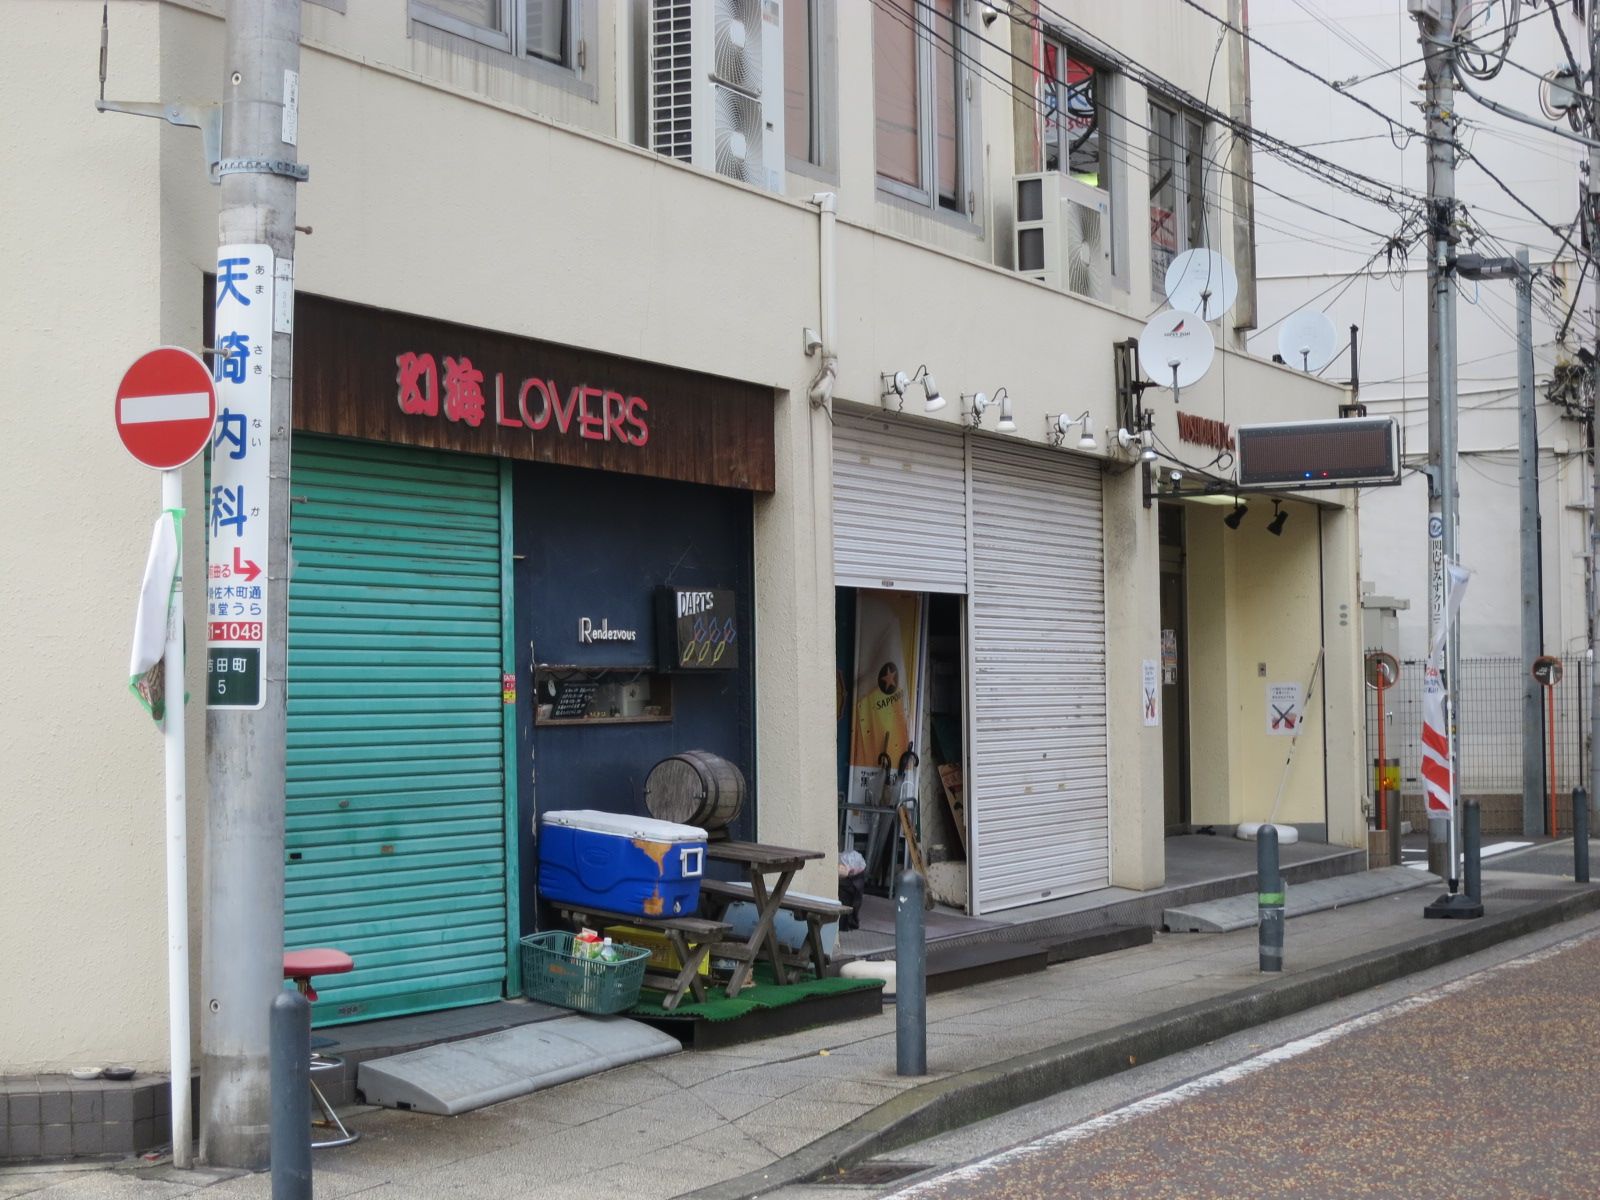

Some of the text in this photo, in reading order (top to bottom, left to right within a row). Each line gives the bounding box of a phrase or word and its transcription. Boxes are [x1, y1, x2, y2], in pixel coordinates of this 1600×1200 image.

[211, 257, 250, 538] 天崎内科
[496, 373, 648, 446] LOVERS
[677, 591, 714, 618] DARTS
[579, 617, 637, 643] Rendezvous
[218, 680, 227, 695] 5
